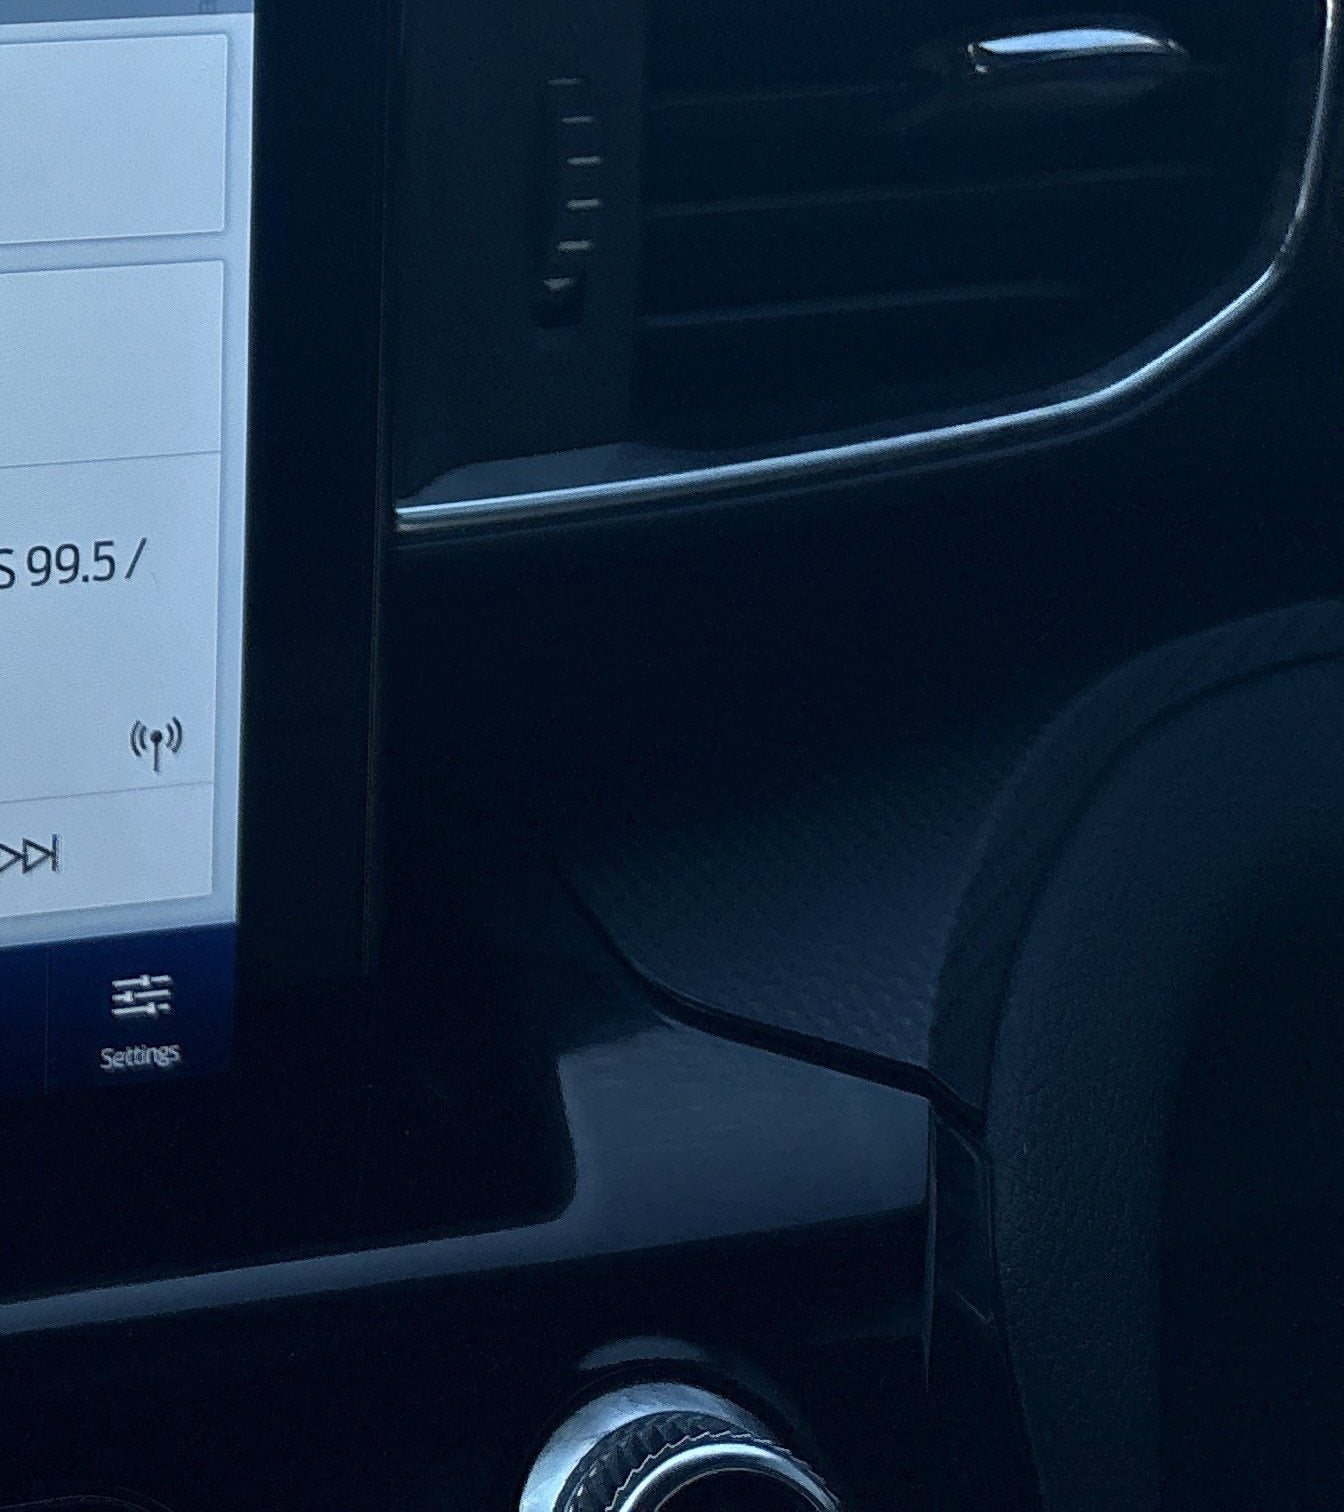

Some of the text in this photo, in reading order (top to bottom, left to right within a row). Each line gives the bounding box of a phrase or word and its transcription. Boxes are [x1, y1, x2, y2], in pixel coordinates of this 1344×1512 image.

[26, 540, 117, 586] 99.5
[124, 536, 148, 580] /
[99, 1040, 181, 1072] Settings
